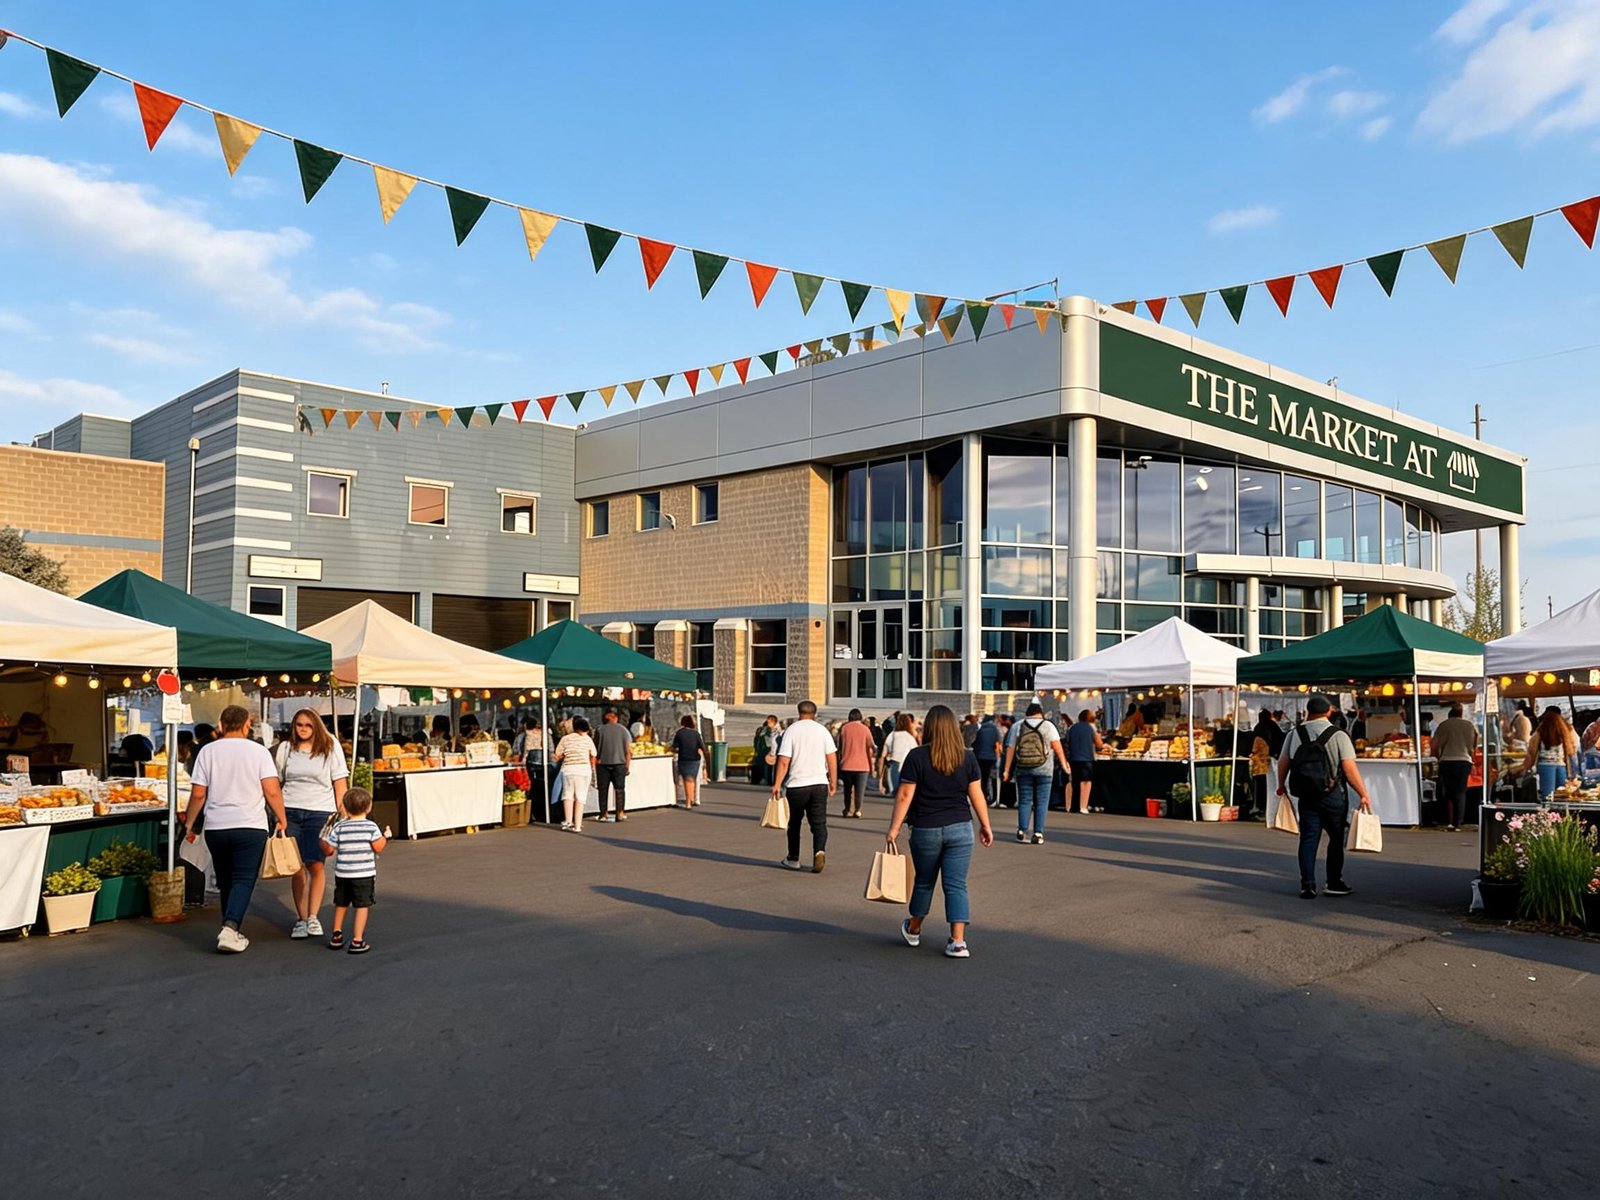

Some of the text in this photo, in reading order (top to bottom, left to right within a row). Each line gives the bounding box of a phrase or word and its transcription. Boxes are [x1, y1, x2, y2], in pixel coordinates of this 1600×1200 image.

[1181, 363, 1438, 479] THE MARKET AT
